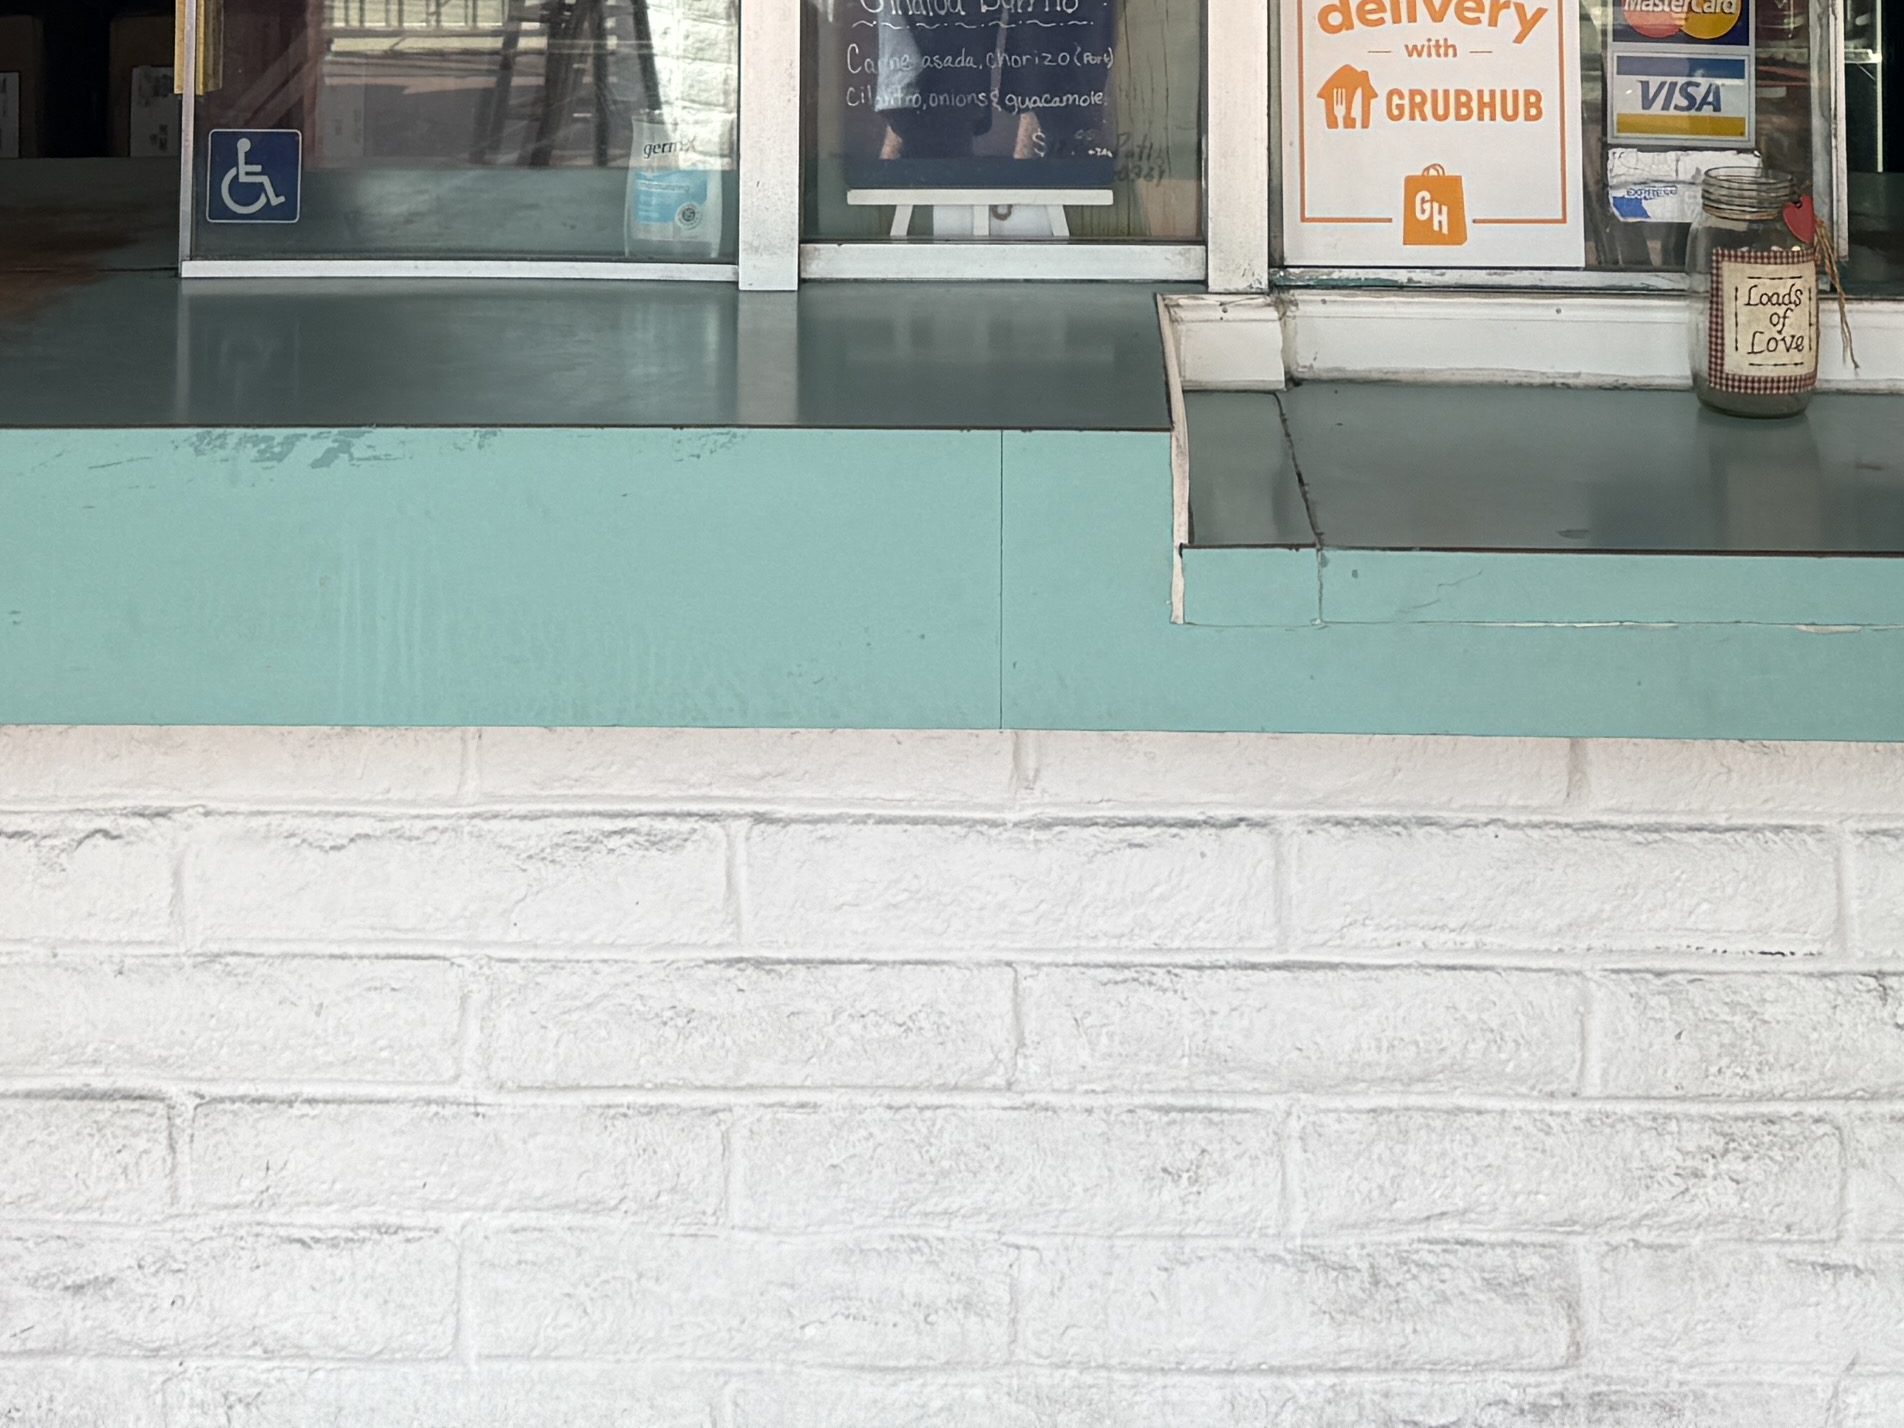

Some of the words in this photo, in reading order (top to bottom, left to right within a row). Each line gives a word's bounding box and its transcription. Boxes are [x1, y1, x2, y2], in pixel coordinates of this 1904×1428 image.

[1404, 38, 1457, 59] with
[1386, 89, 1543, 122] GRUBHUB
[1638, 80, 1722, 112] VISA
[1743, 283, 1803, 307] Loads
[1769, 310, 1791, 334] of
[1747, 331, 1804, 354] Love
